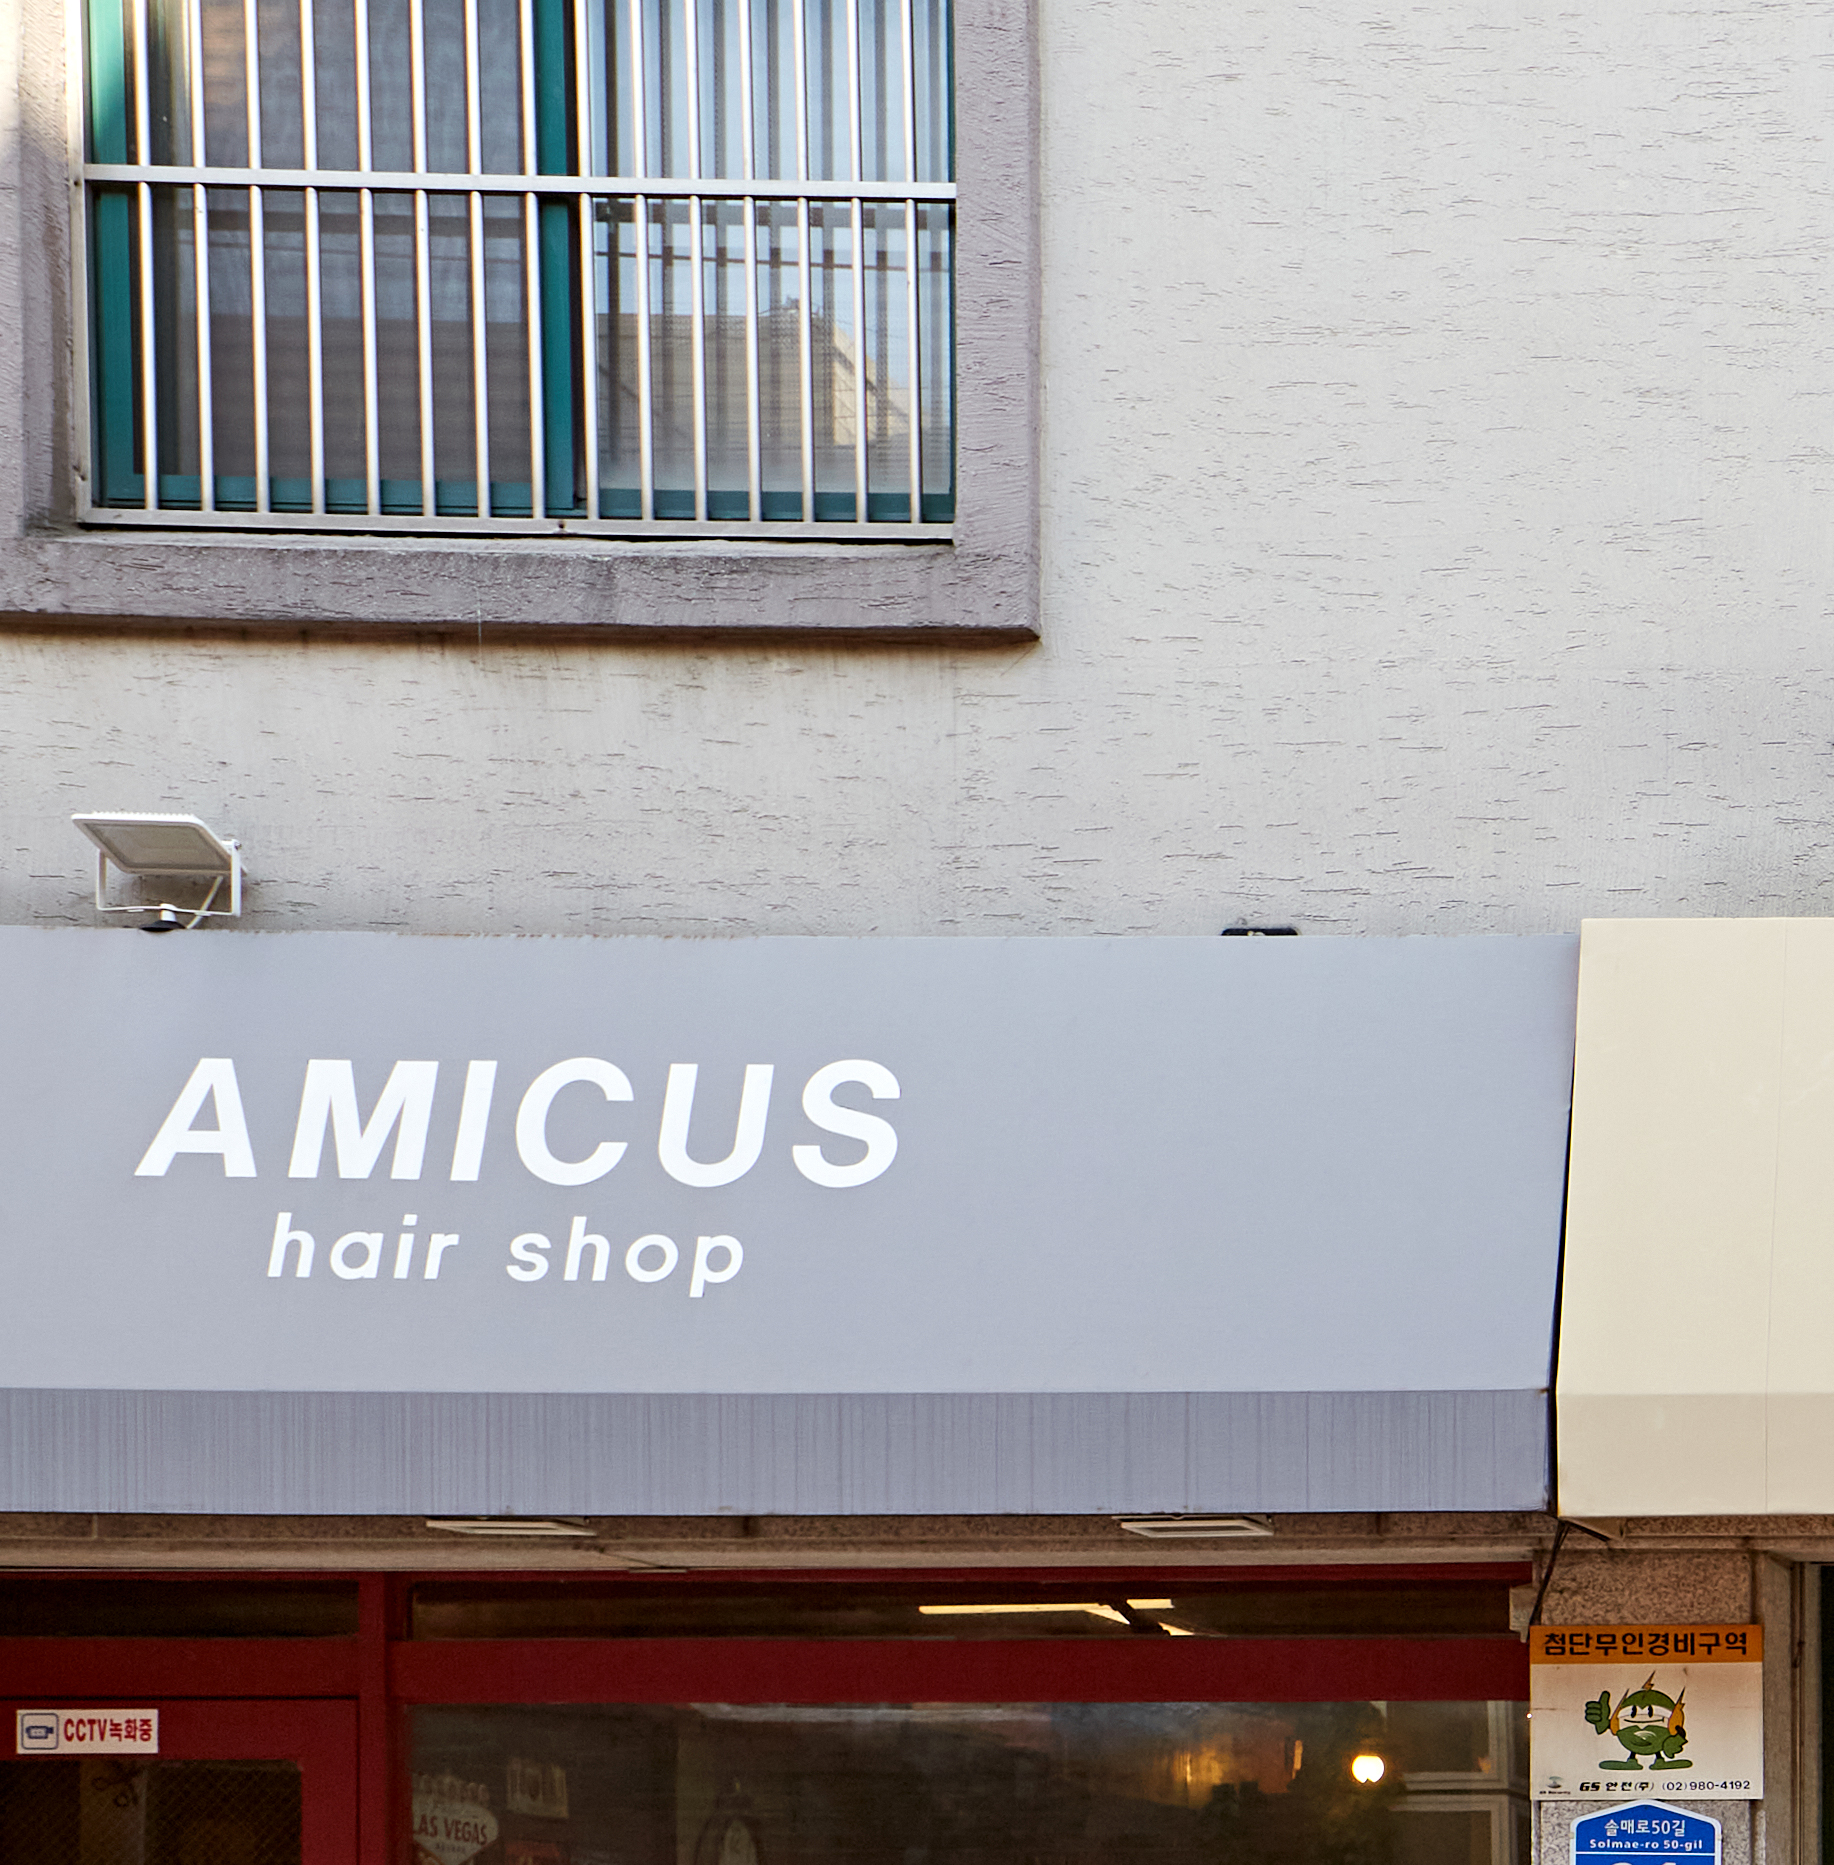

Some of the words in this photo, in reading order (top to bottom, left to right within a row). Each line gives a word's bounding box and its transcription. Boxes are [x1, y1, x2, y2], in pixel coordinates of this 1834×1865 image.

[134, 1057, 902, 1188] AMICUS
[267, 1212, 459, 1281] hair
[506, 1215, 745, 1298] shop
[1543, 1632, 1748, 1656] 첨단무인경비구역
[63, 1718, 153, 1742] CCTV녹화중
[1578, 1781, 1601, 1792] GS
[1661, 1780, 1751, 1792] (02)980-4192
[1604, 1819, 1686, 1838] 솔매로50길
[1589, 1839, 1660, 1850] Solmae-ro
[1663, 1839, 1703, 1851] 50-gil
